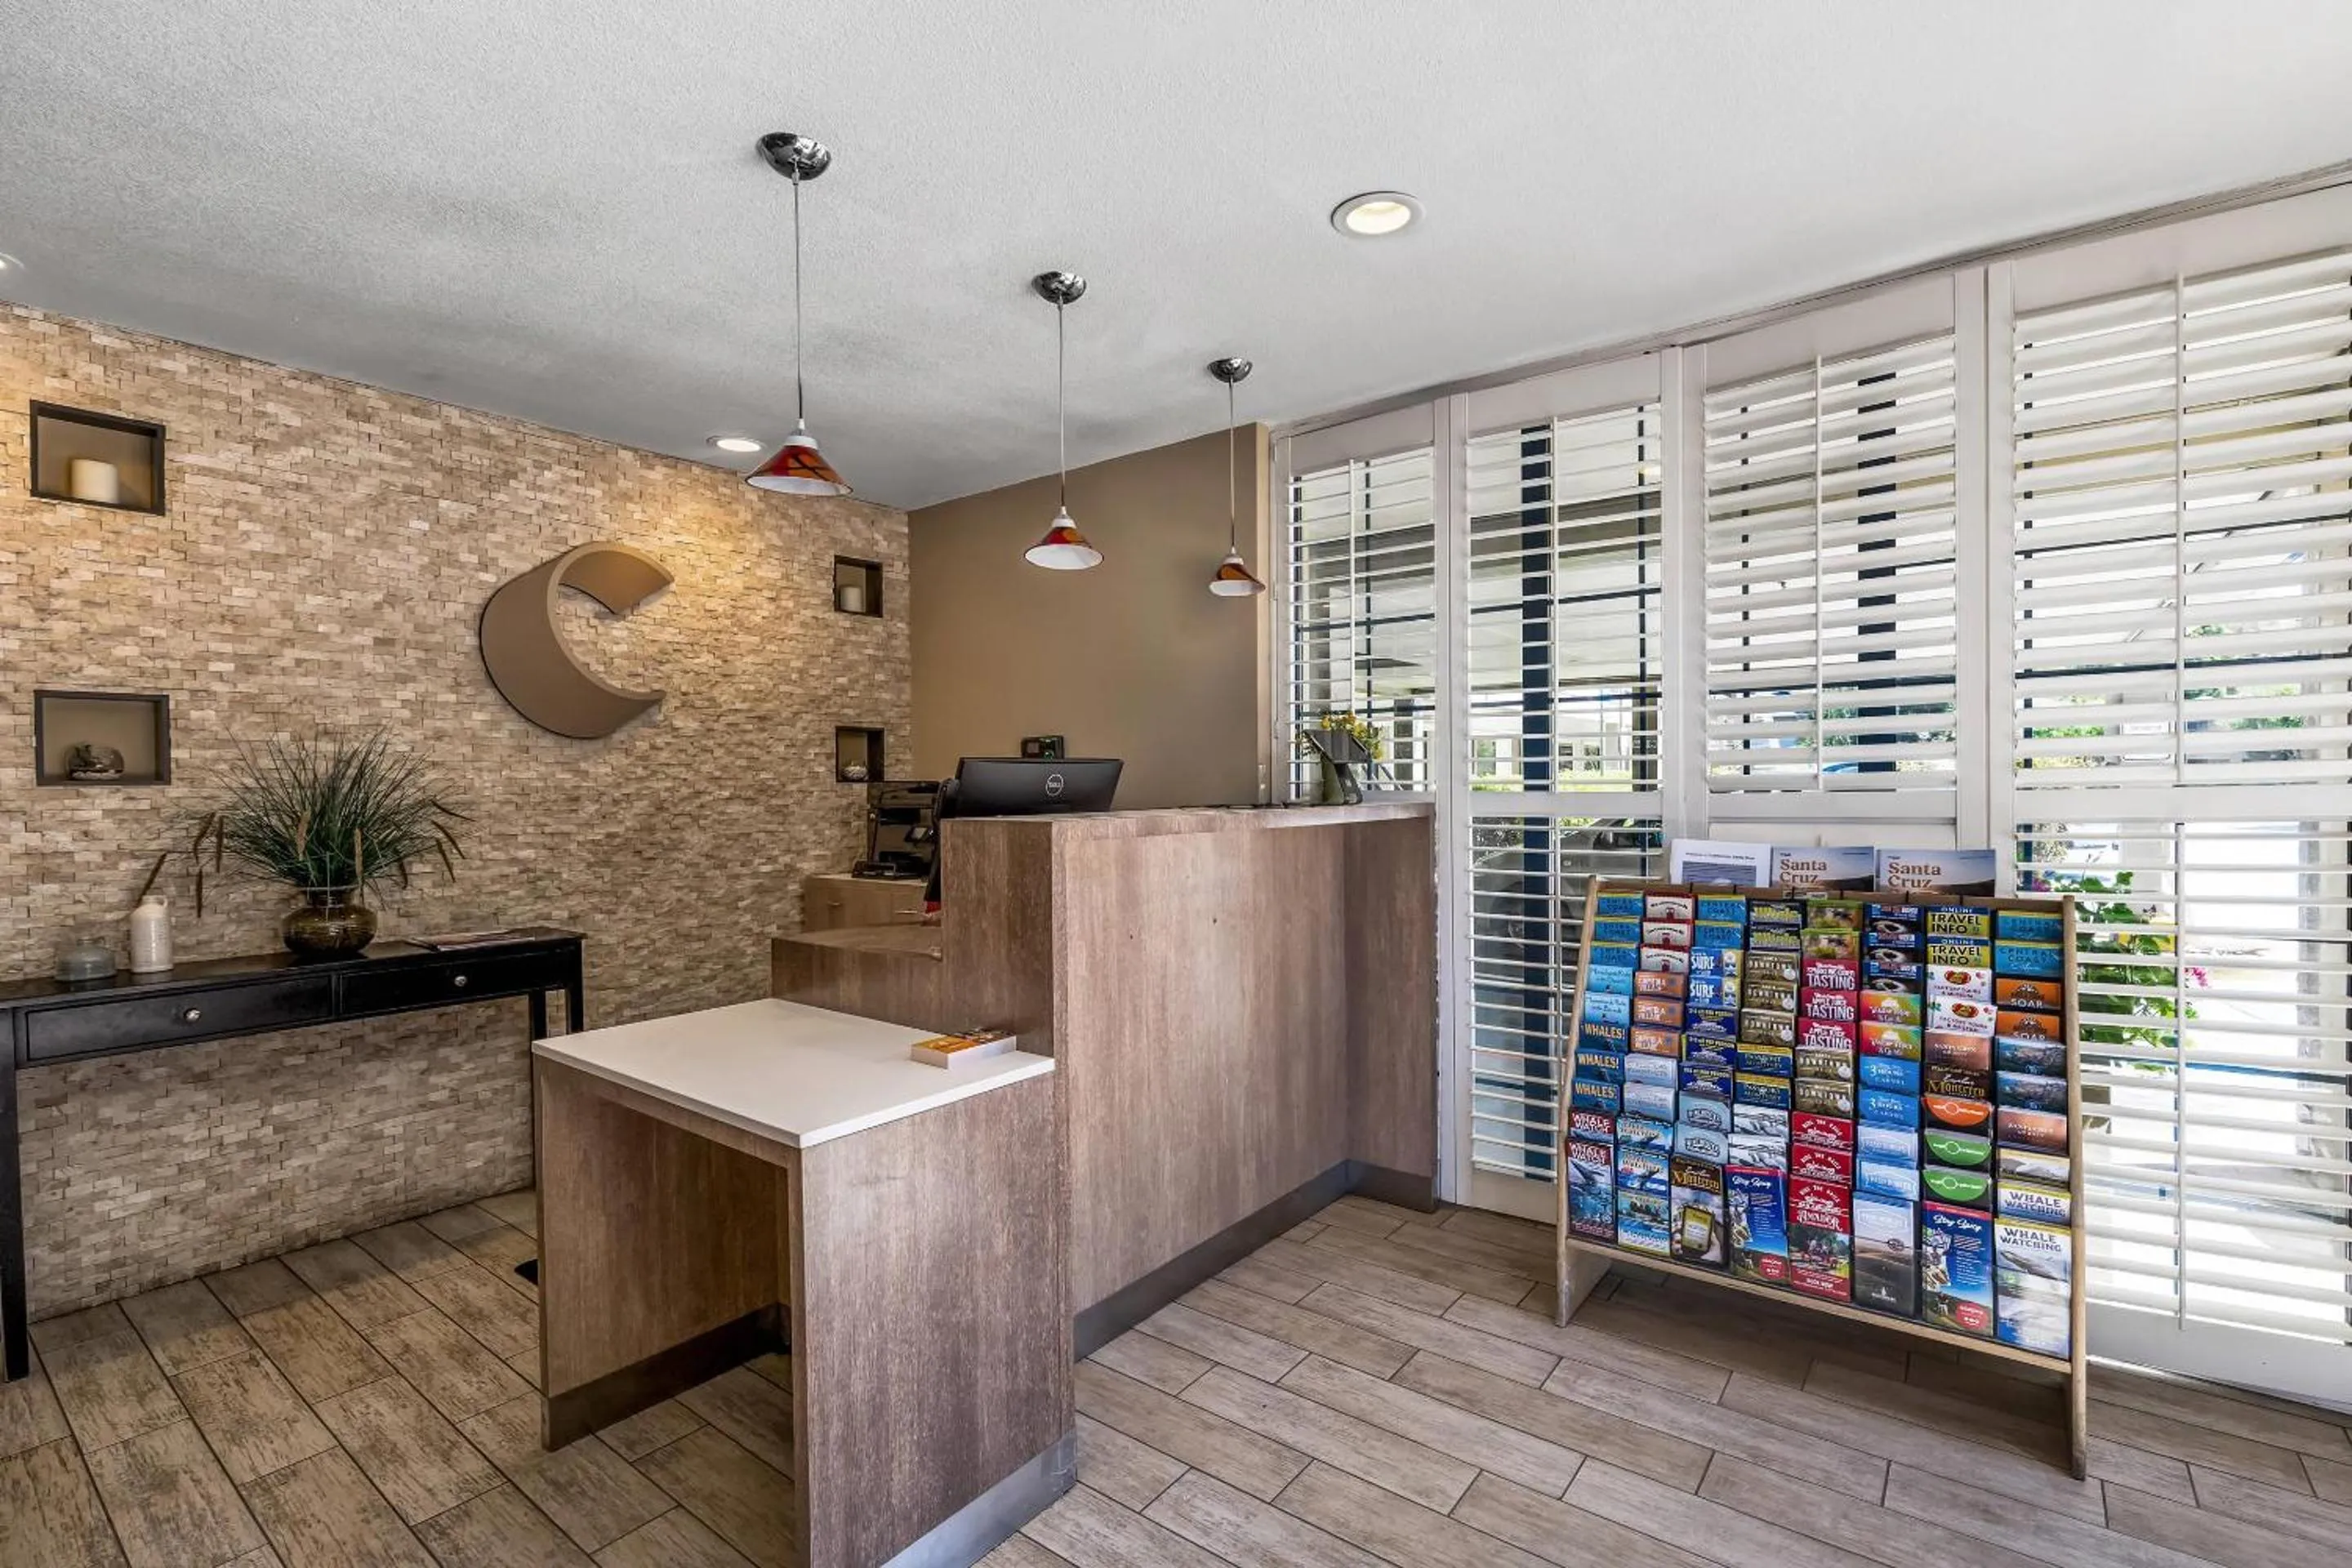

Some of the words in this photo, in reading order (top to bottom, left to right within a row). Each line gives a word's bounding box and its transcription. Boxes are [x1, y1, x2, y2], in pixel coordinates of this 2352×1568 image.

[1780, 859, 1827, 871] Santa
[1888, 862, 1941, 875] Santa
[1780, 871, 1818, 884] Cruz
[1888, 875, 1932, 889] Cruz
[1931, 914, 1981, 924] TRAVEL
[1932, 924, 1967, 933] INFO
[1931, 946, 1980, 956] TRAVEL
[1690, 956, 1714, 969] SURF
[1933, 956, 1969, 965] INFO
[1807, 973, 1855, 990] TASTING
[1690, 983, 1714, 1000] SURF
[1806, 1003, 1854, 1020] TASTING
[1584, 1023, 1625, 1040] WHALES!
[1803, 1033, 1852, 1049] TASTING
[1577, 1054, 1619, 1069] WHALES!
[1571, 1112, 1610, 1128] WHALE
[2008, 1191, 2061, 1208] WHALE
[2004, 1199, 2066, 1217] WATCHING
[2003, 1227, 2057, 1244] WHALE
[2000, 1236, 2062, 1252] WATCHING
